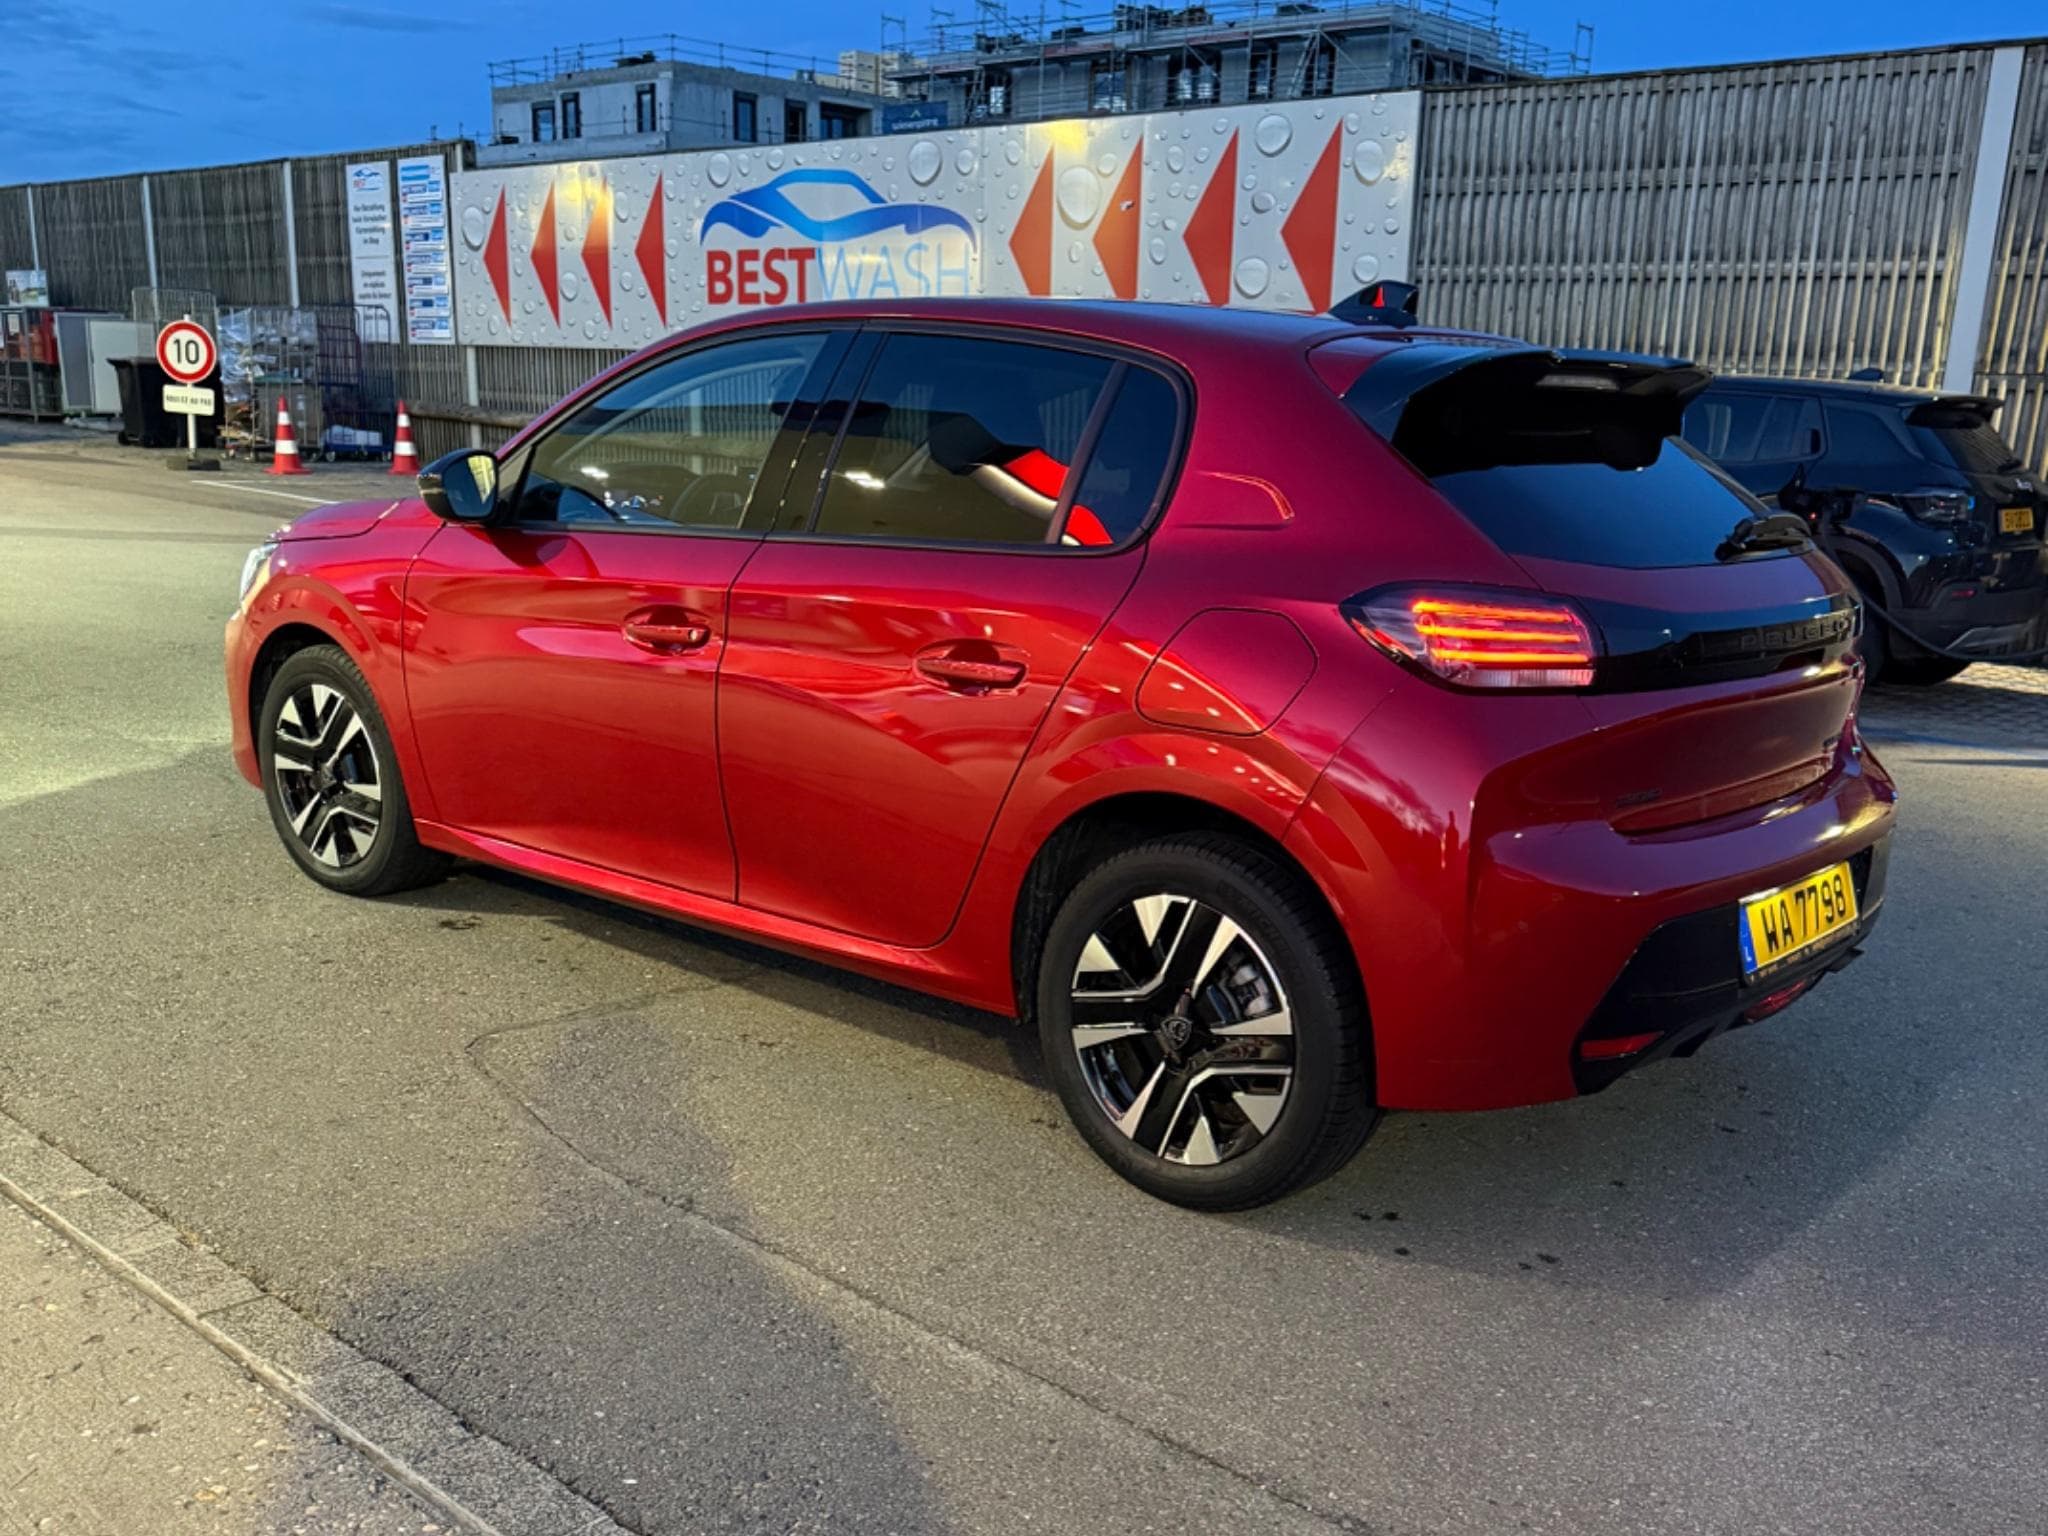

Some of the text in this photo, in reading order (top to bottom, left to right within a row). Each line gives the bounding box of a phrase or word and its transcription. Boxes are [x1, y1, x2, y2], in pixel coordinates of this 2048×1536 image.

[173, 339, 199, 364] 10
[1741, 614, 1850, 650] PEUGEO
[1761, 898, 1794, 953] WA
[1794, 874, 1846, 938] 7798
